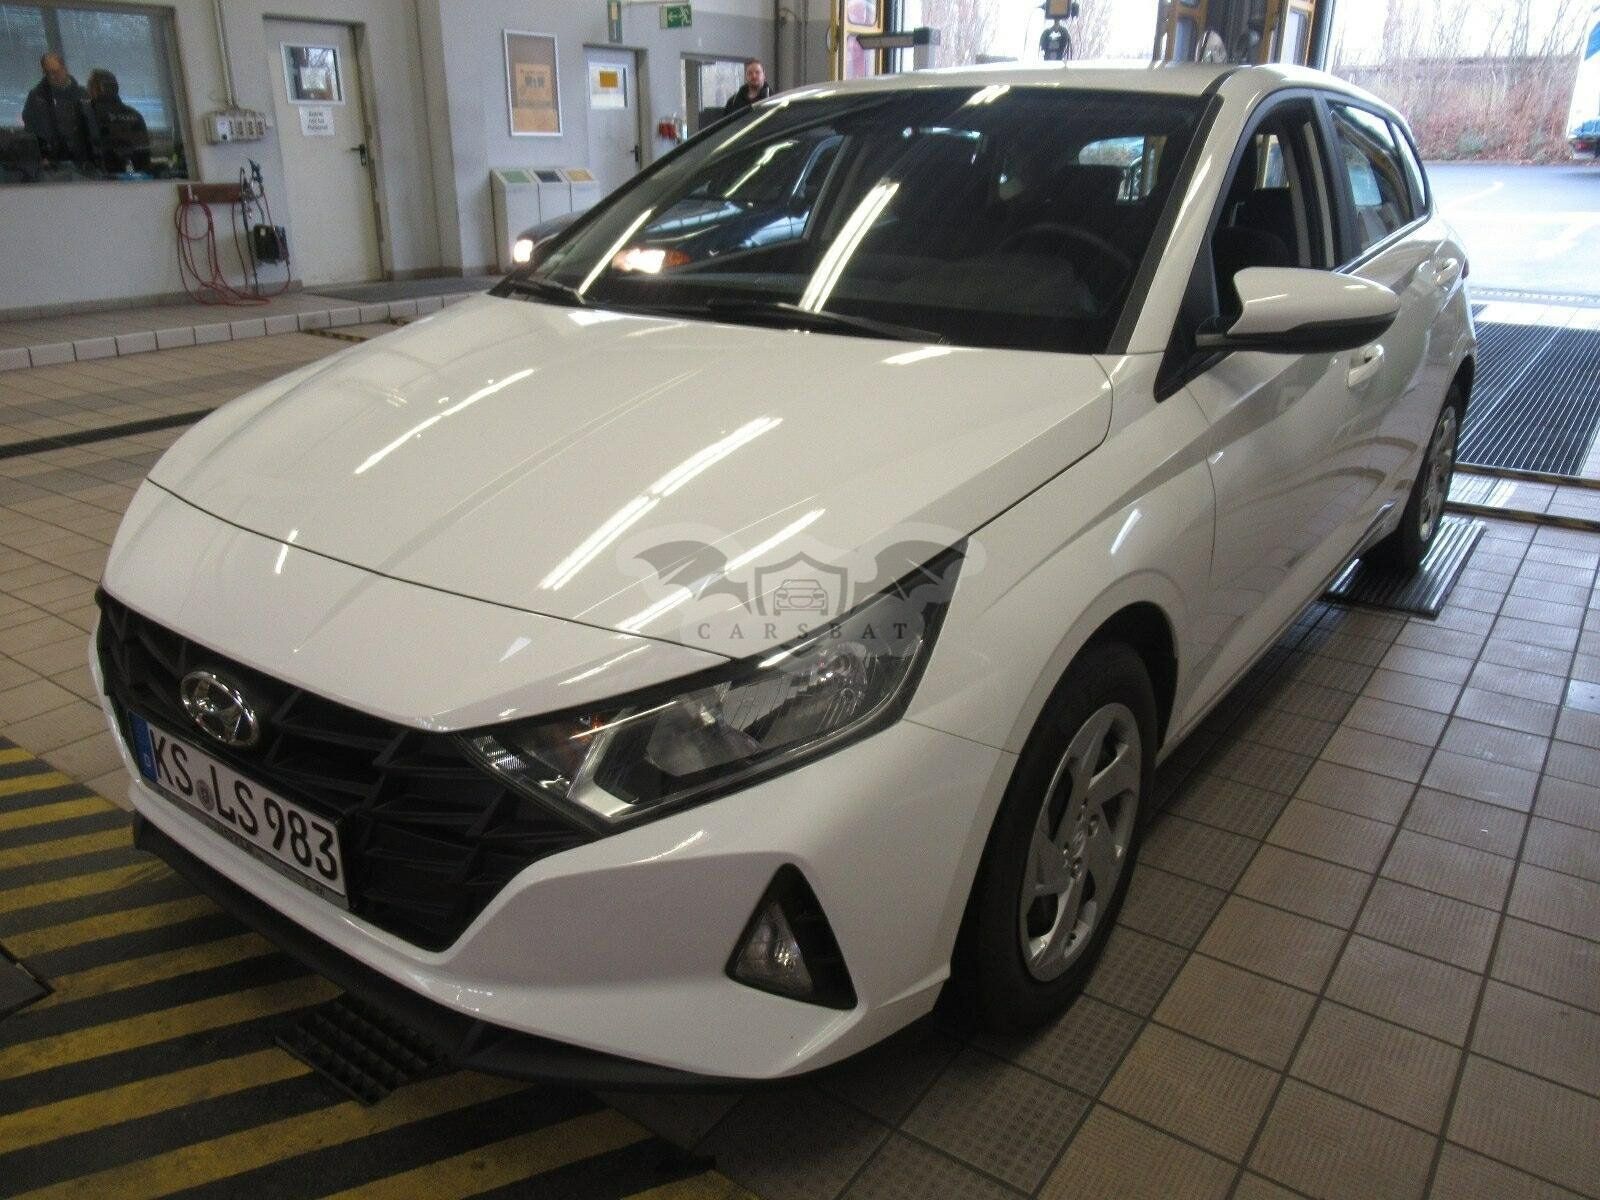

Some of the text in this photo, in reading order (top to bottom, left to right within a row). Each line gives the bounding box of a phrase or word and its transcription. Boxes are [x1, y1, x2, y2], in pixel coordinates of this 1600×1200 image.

[150, 729, 338, 880] KS LS 983
